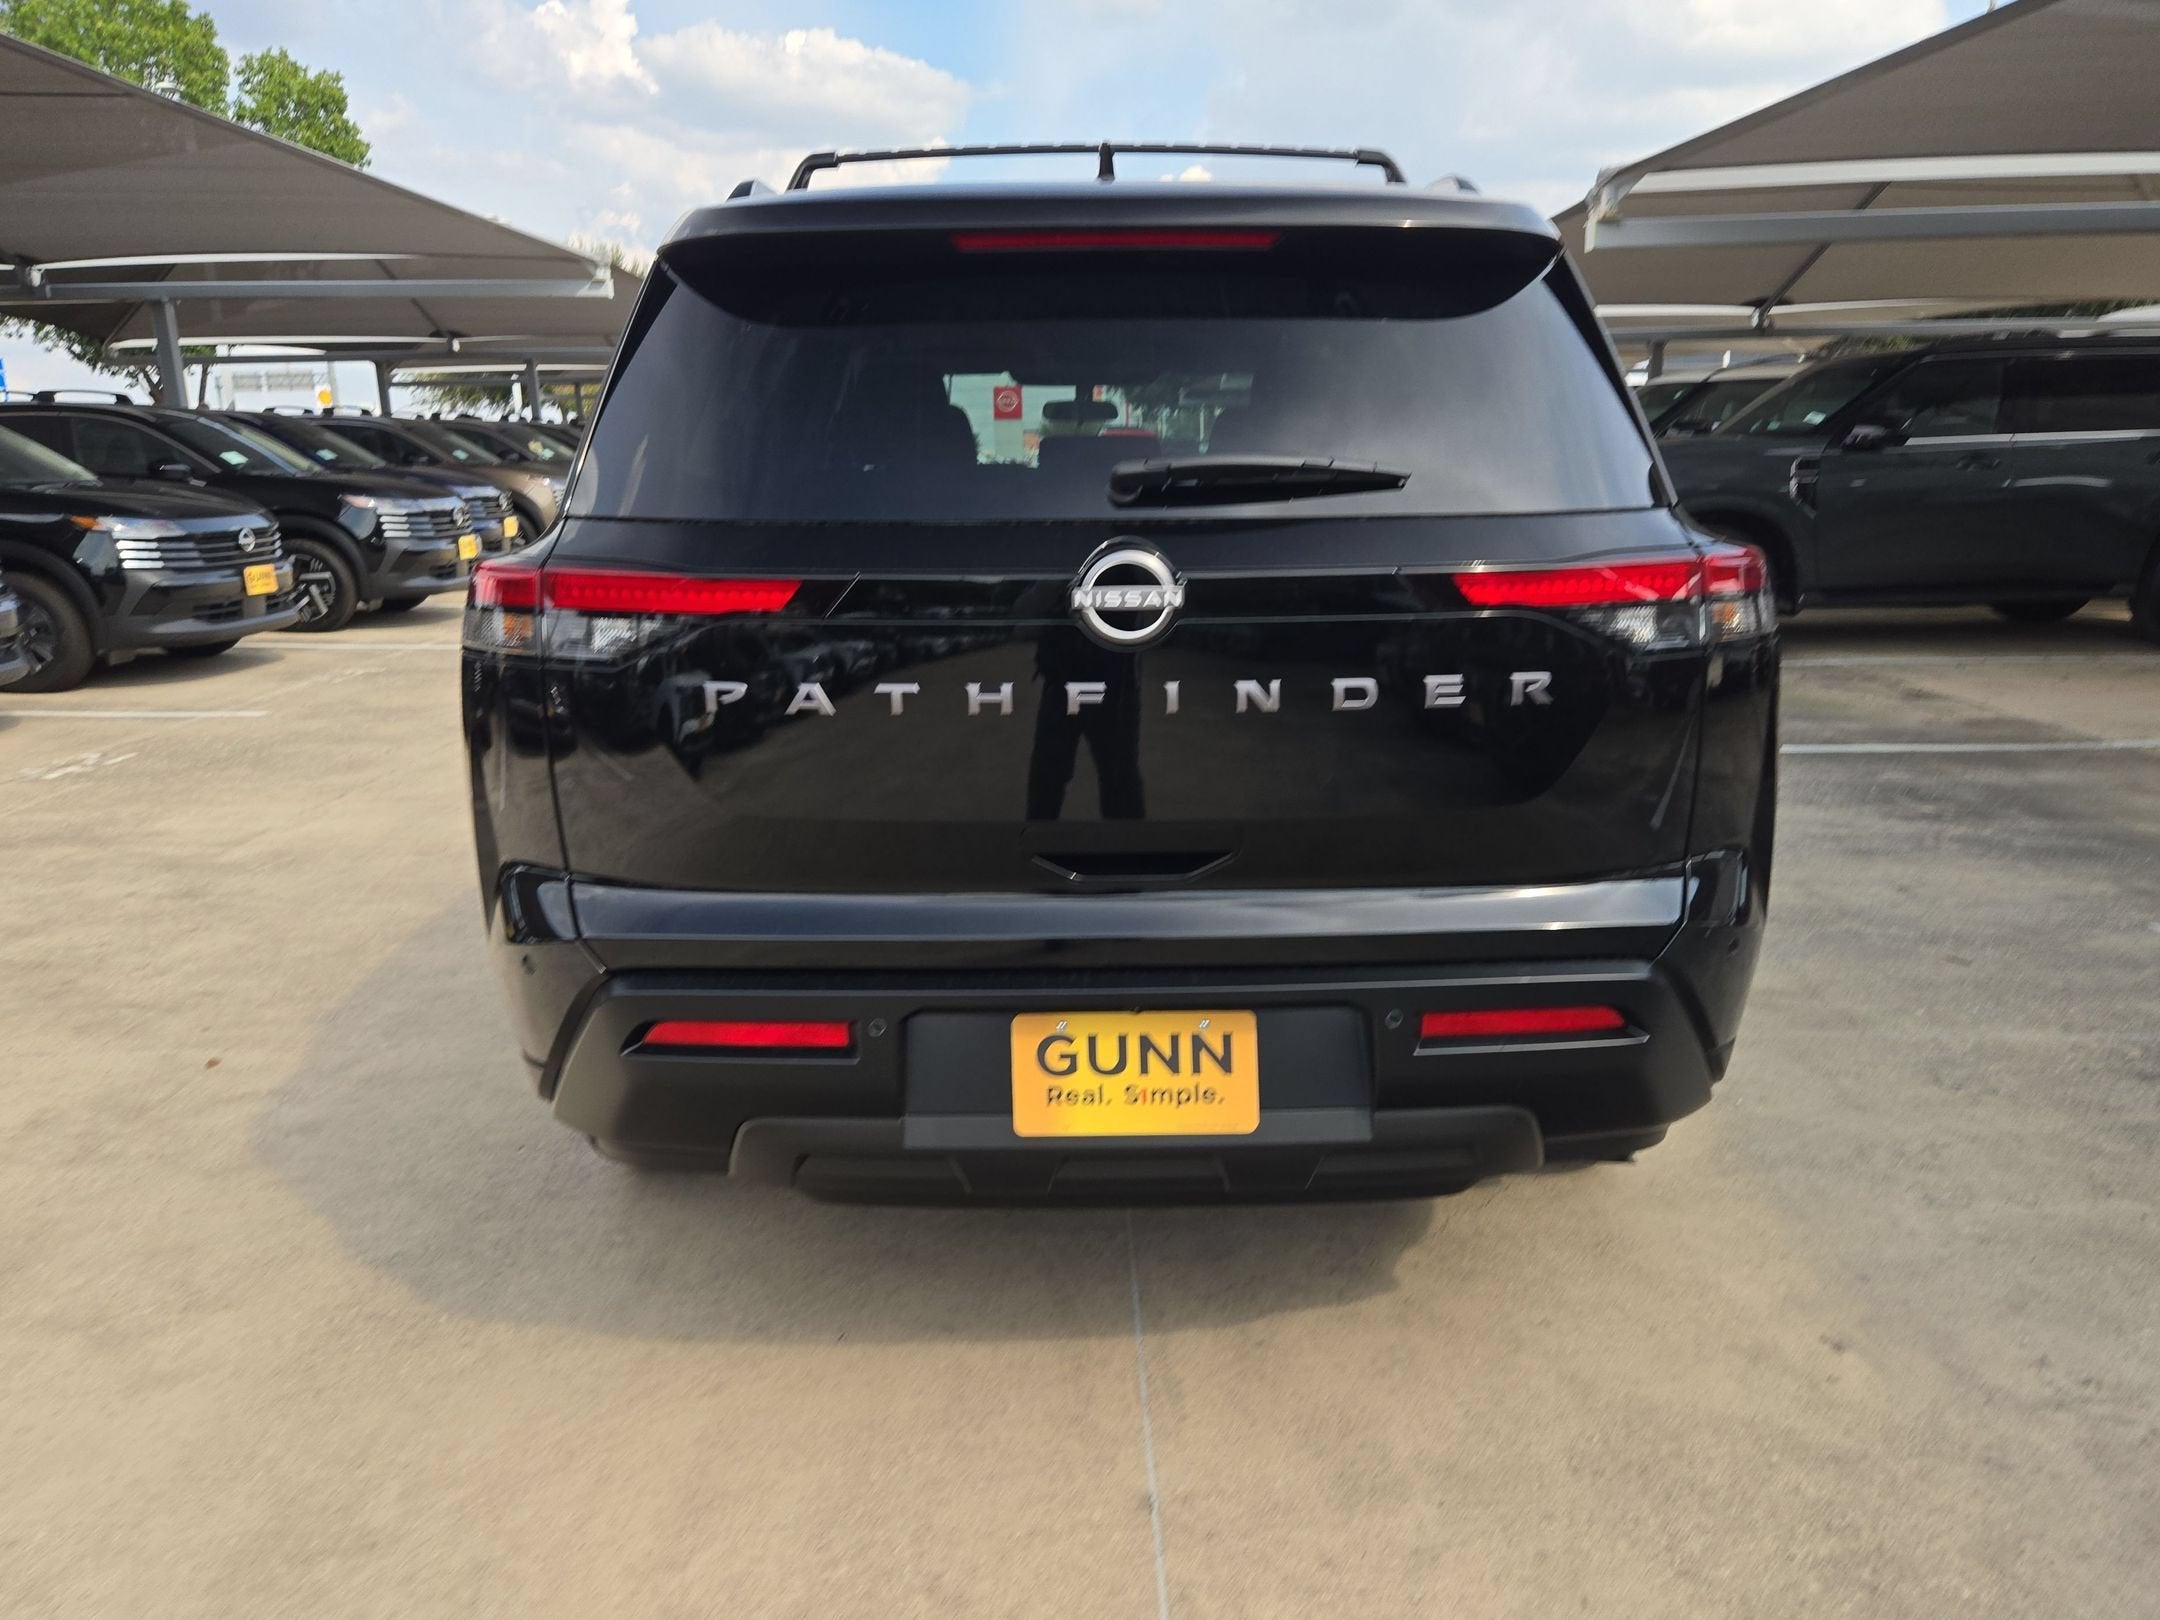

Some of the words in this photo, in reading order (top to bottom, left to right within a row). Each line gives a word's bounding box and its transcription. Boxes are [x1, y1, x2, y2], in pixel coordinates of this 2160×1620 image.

[1073, 589, 1183, 608] NISSAN
[702, 671, 1554, 717] PATHFINDER
[1036, 1033, 1234, 1076] GUNN
[1046, 1083, 1112, 1106] Real.
[1123, 1081, 1226, 1108] Simple.
